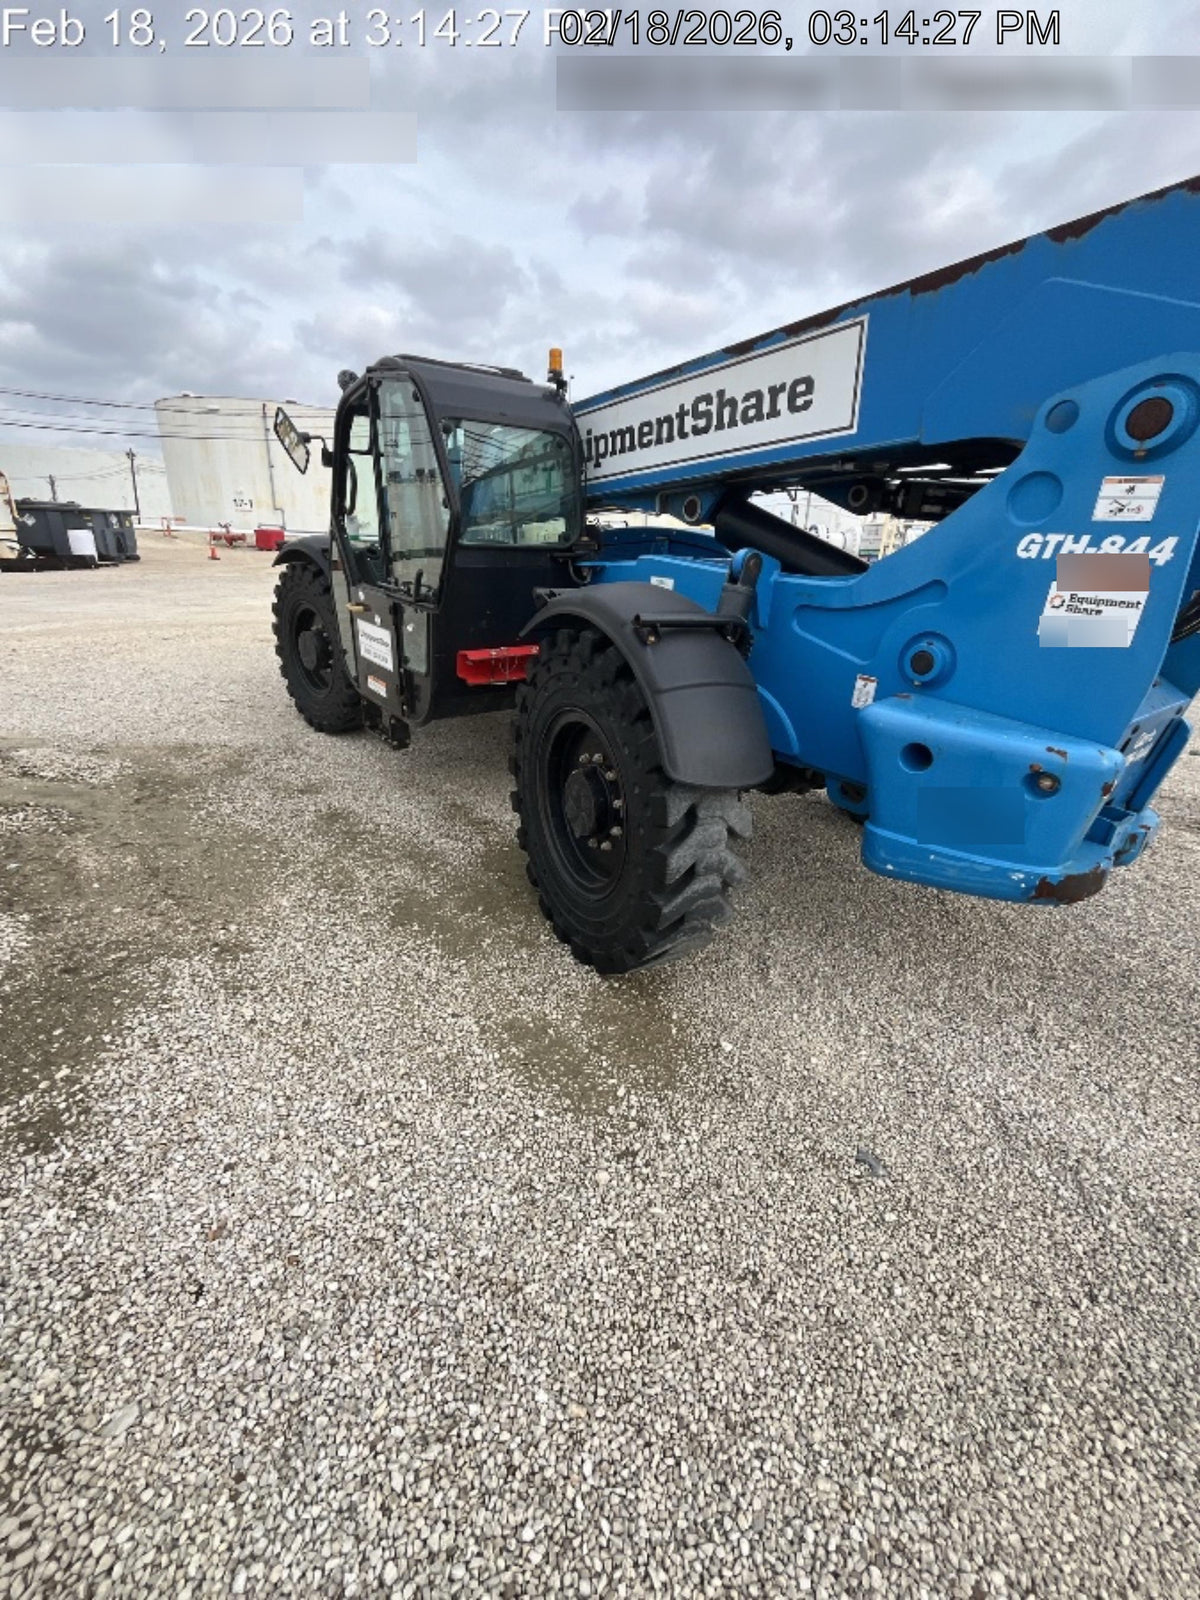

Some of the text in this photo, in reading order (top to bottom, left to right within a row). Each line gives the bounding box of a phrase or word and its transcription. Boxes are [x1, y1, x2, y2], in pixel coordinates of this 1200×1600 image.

[580, 374, 815, 469] ipmentShare
[1016, 532, 1179, 566] GTH-844
[1065, 604, 1103, 616] Share
[1069, 593, 1142, 610] Equipment
